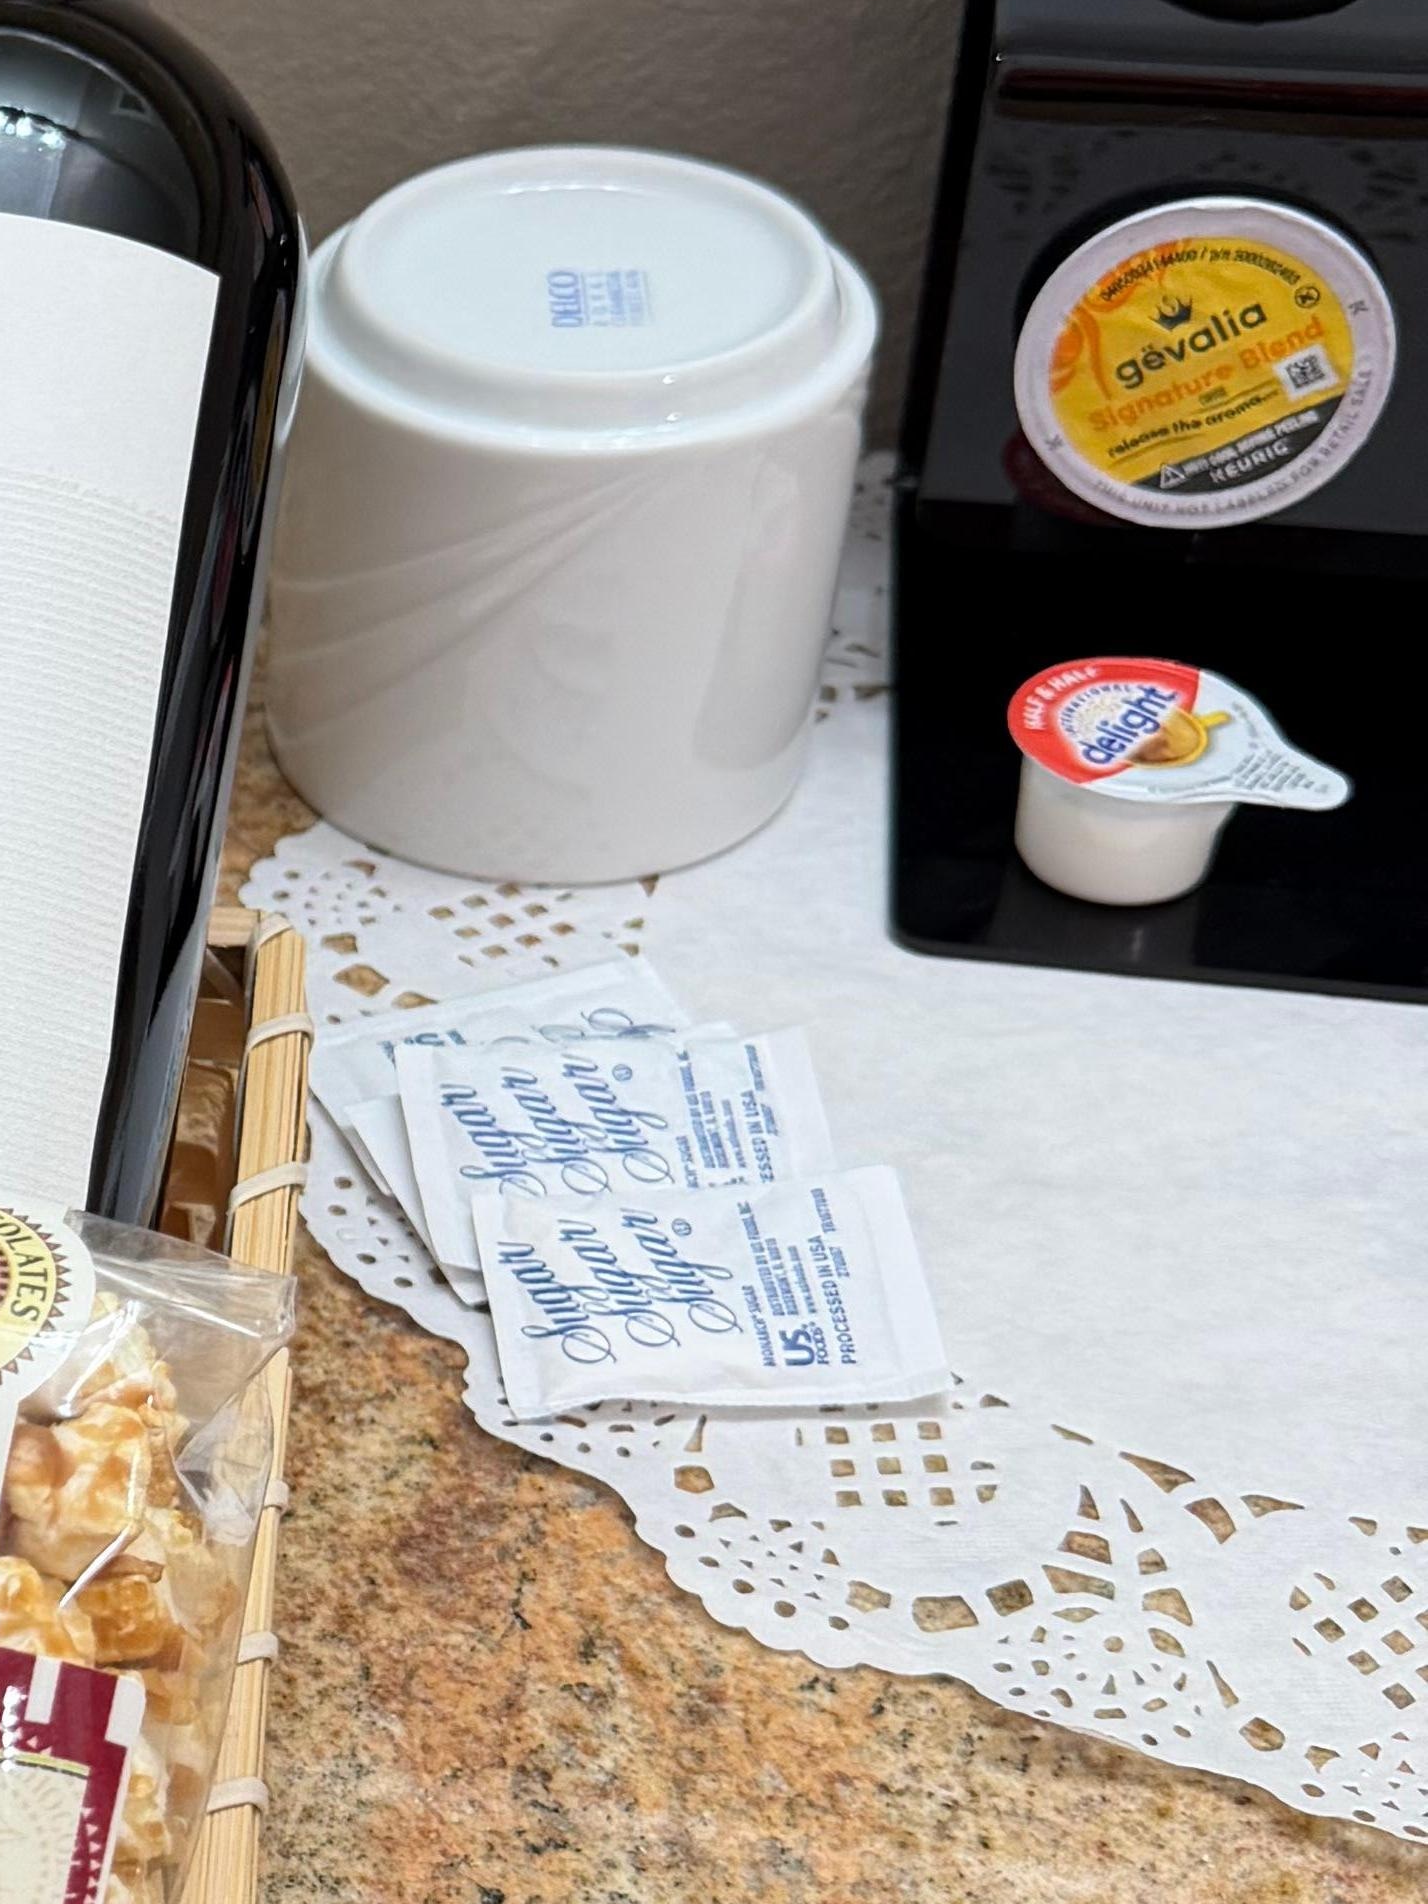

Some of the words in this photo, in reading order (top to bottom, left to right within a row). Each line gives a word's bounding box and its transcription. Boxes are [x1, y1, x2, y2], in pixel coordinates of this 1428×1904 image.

[1086, 362, 1234, 433] Signature
[1238, 316, 1326, 373] Blend
[1114, 299, 1268, 391] gëvalia
[1108, 425, 1170, 459] release
[1172, 418, 1203, 435] the
[1209, 438, 1289, 484] KEURIG
[1077, 686, 1178, 765] delight
[500, 1065, 613, 1195] Sugar
[561, 1053, 676, 1185] Sugar
[741, 1089, 760, 1117] USA
[497, 1241, 617, 1364] Sugar
[557, 1219, 681, 1348] Sugar
[619, 1207, 744, 1334] Sugar
[807, 1234, 828, 1262] USA
[815, 1262, 834, 1278] IN
[821, 1279, 857, 1365] PROCESSED
